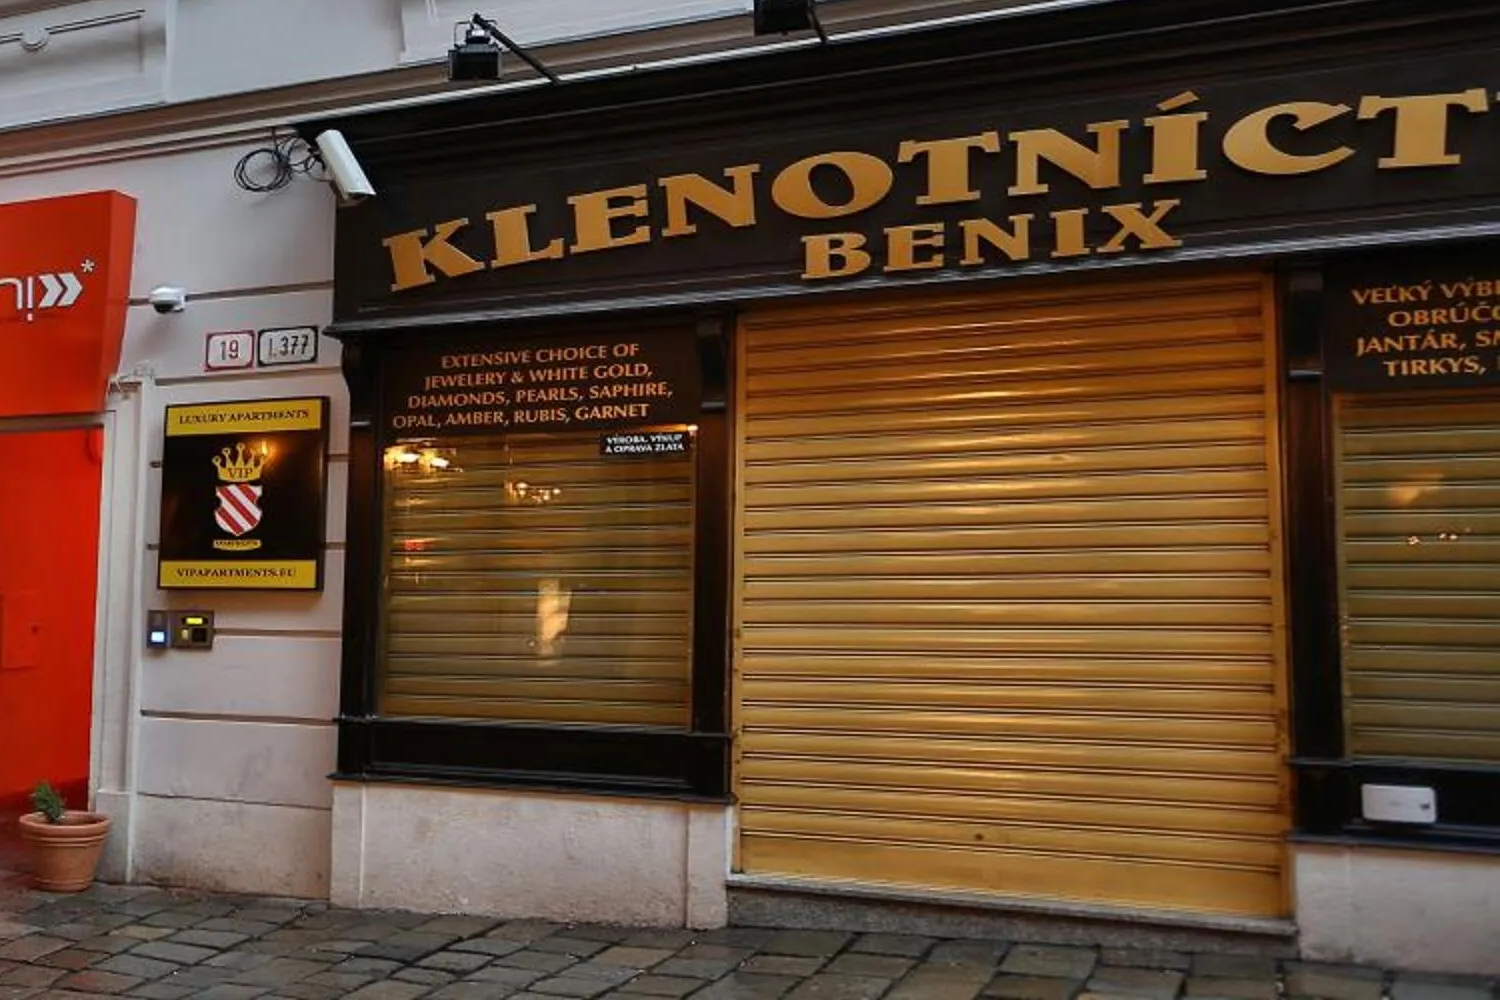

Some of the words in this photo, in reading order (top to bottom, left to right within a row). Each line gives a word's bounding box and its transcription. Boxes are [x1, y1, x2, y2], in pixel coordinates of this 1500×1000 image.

[382, 87, 1500, 292] KLENOTNÍCT
[800, 198, 1184, 279] BENIX
[1440, 276, 1500, 299] VÝB
[220, 339, 239, 361] 19
[1356, 328, 1467, 357] JANTÁR,
[441, 349, 531, 369] EXTENSIVE
[535, 345, 607, 363] CHOICE
[612, 343, 640, 357] OF
[1381, 355, 1487, 377] TIRKYS,
[424, 370, 506, 391] JEWELERY
[510, 369, 525, 384] &
[528, 366, 588, 382] WHITE
[593, 363, 653, 379] GOLD,
[407, 391, 511, 409] DIAMONDS,
[515, 386, 584, 404] PEARLS,
[588, 380, 673, 399] SAPHIRE,
[179, 414, 226, 425] LUXURY
[228, 409, 309, 422] APARTMENTS
[392, 413, 441, 429] OPAL,
[444, 411, 509, 427] AMBER,
[513, 407, 571, 424] RUBIS,
[574, 403, 649, 420] GARNET
[227, 467, 254, 480] VIP
